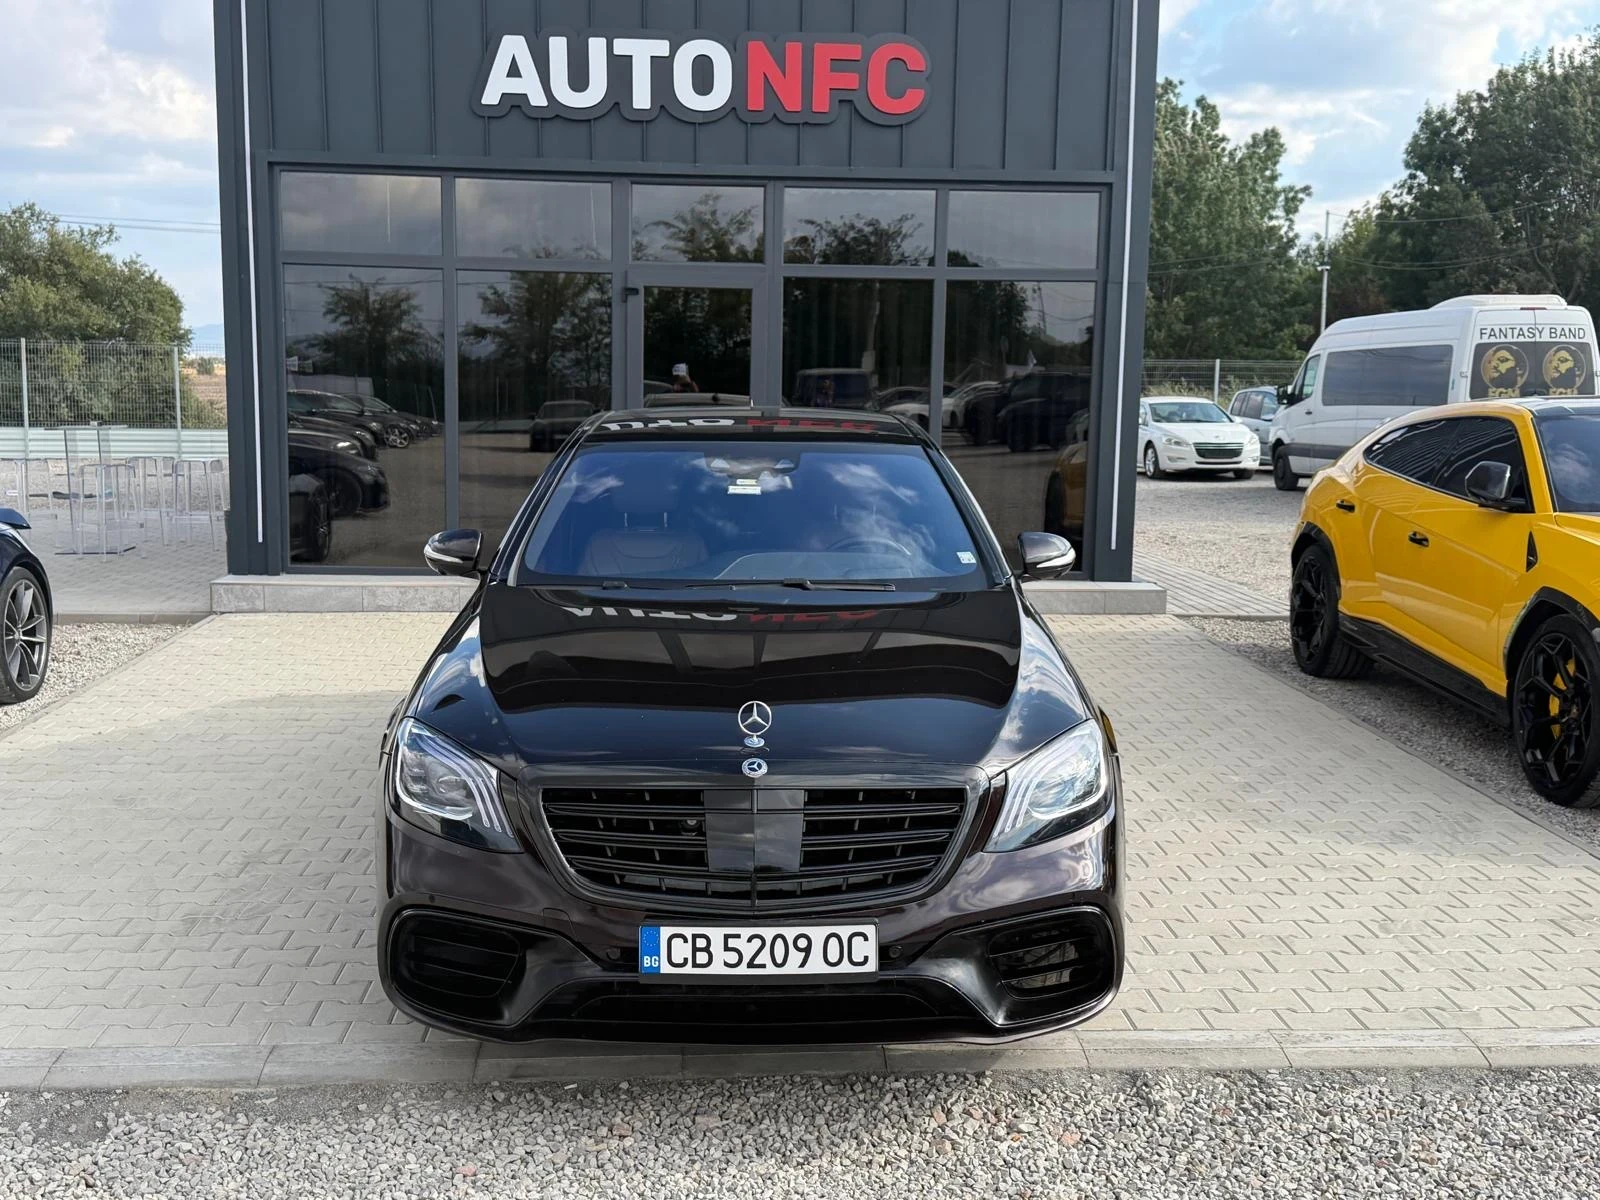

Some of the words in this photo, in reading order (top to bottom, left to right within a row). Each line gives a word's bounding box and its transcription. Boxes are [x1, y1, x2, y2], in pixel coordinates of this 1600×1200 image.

[480, 34, 732, 112] AUTO
[746, 39, 927, 115] NFC
[1479, 326, 1545, 340] FANTASY
[1549, 327, 1586, 340] BAND
[643, 955, 660, 967] BG
[666, 932, 713, 968] CB
[723, 933, 813, 969] 5209
[822, 931, 869, 967] OC
